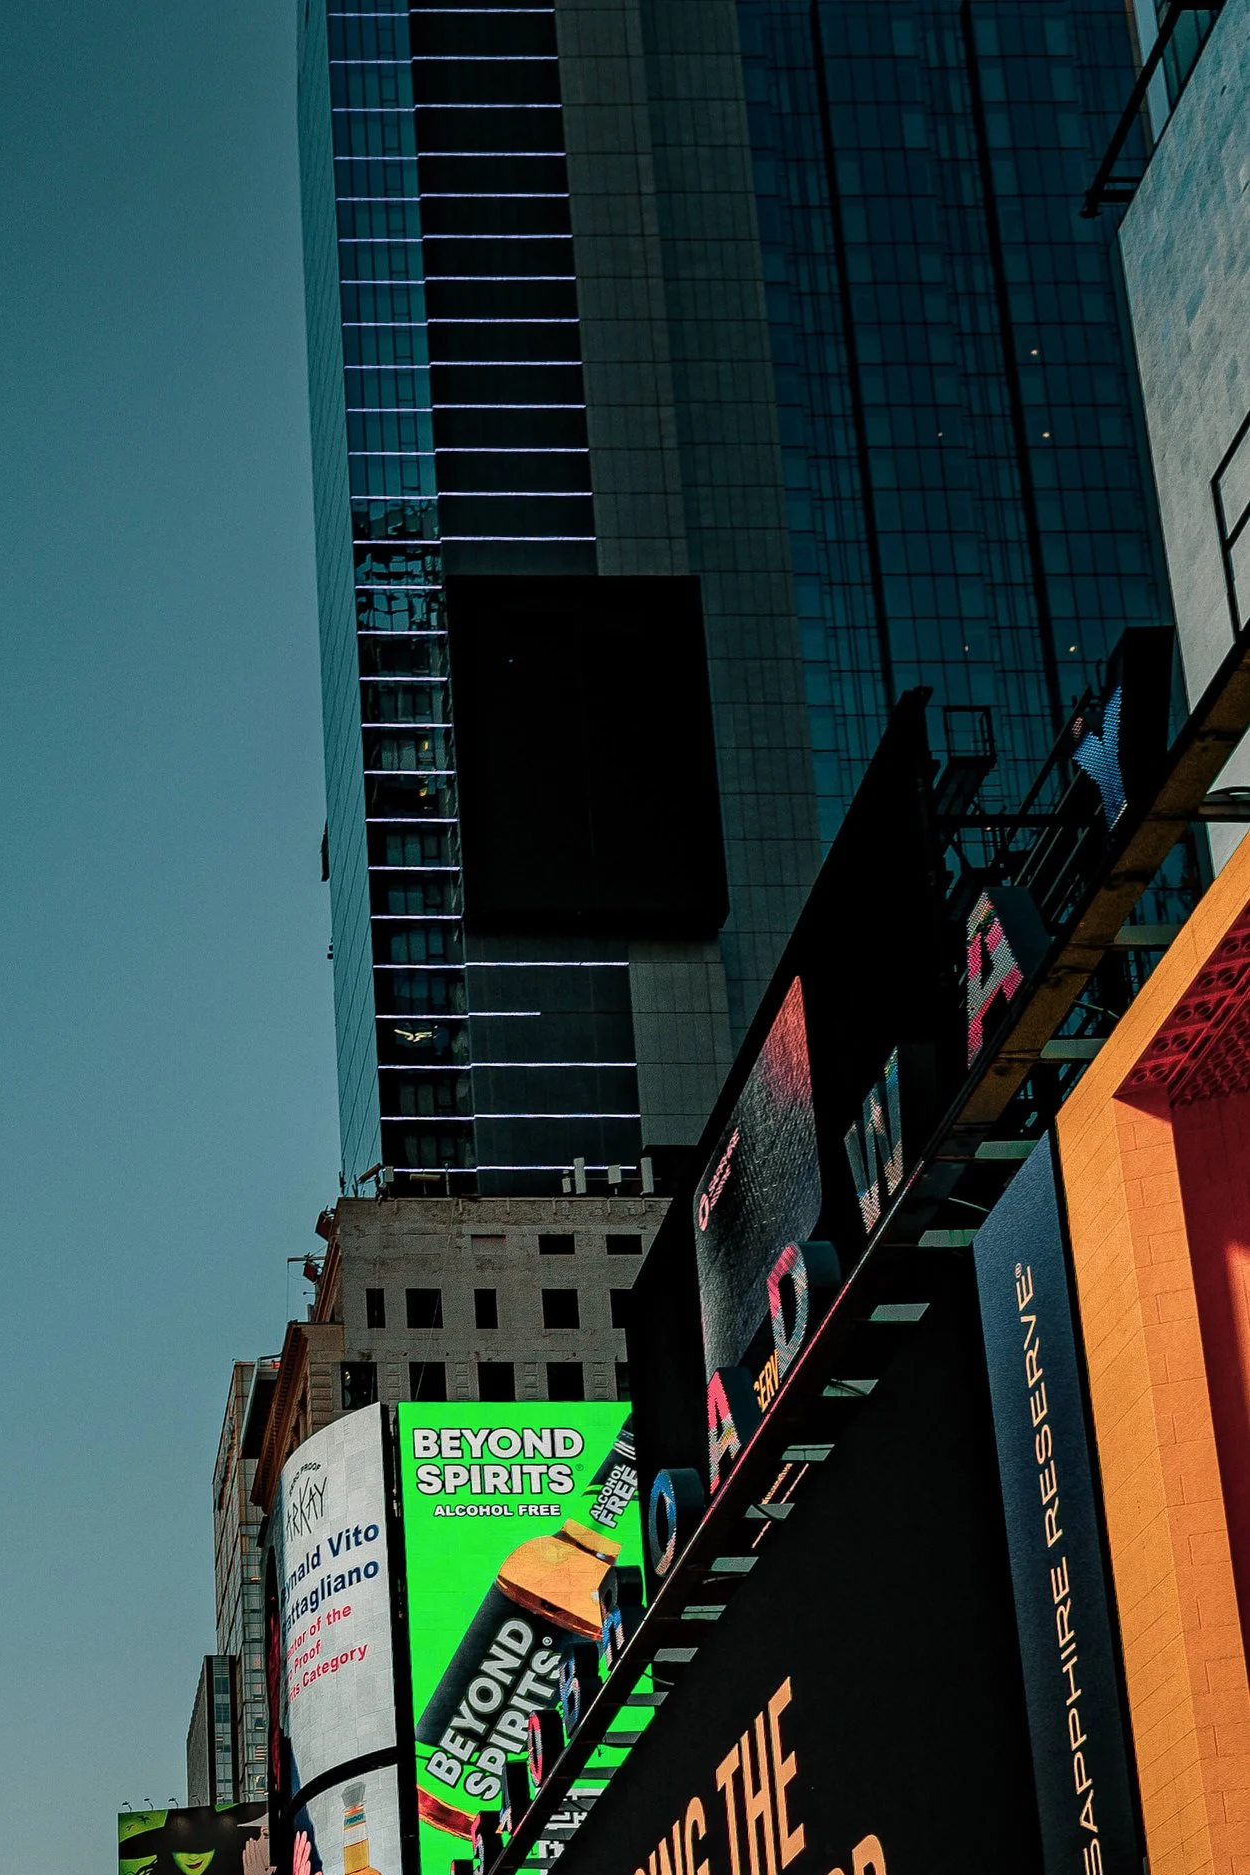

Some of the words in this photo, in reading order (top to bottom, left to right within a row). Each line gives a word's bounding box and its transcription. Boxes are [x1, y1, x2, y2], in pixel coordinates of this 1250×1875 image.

[412, 1426, 586, 1460] BEYOND
[285, 1477, 328, 1544] ARKAY
[434, 1504, 514, 1518] ALCOHOL
[517, 1504, 562, 1517] FREE
[589, 1463, 627, 1520] ALCOHOL
[598, 1466, 639, 1529] FREE
[281, 1544, 321, 1603] eynald
[327, 1522, 380, 1559] Vito
[309, 1616, 322, 1638] of
[326, 1603, 353, 1626] the
[293, 1640, 322, 1673] Proof
[302, 1642, 369, 1688] Category
[426, 1616, 535, 1788] BEYOND
